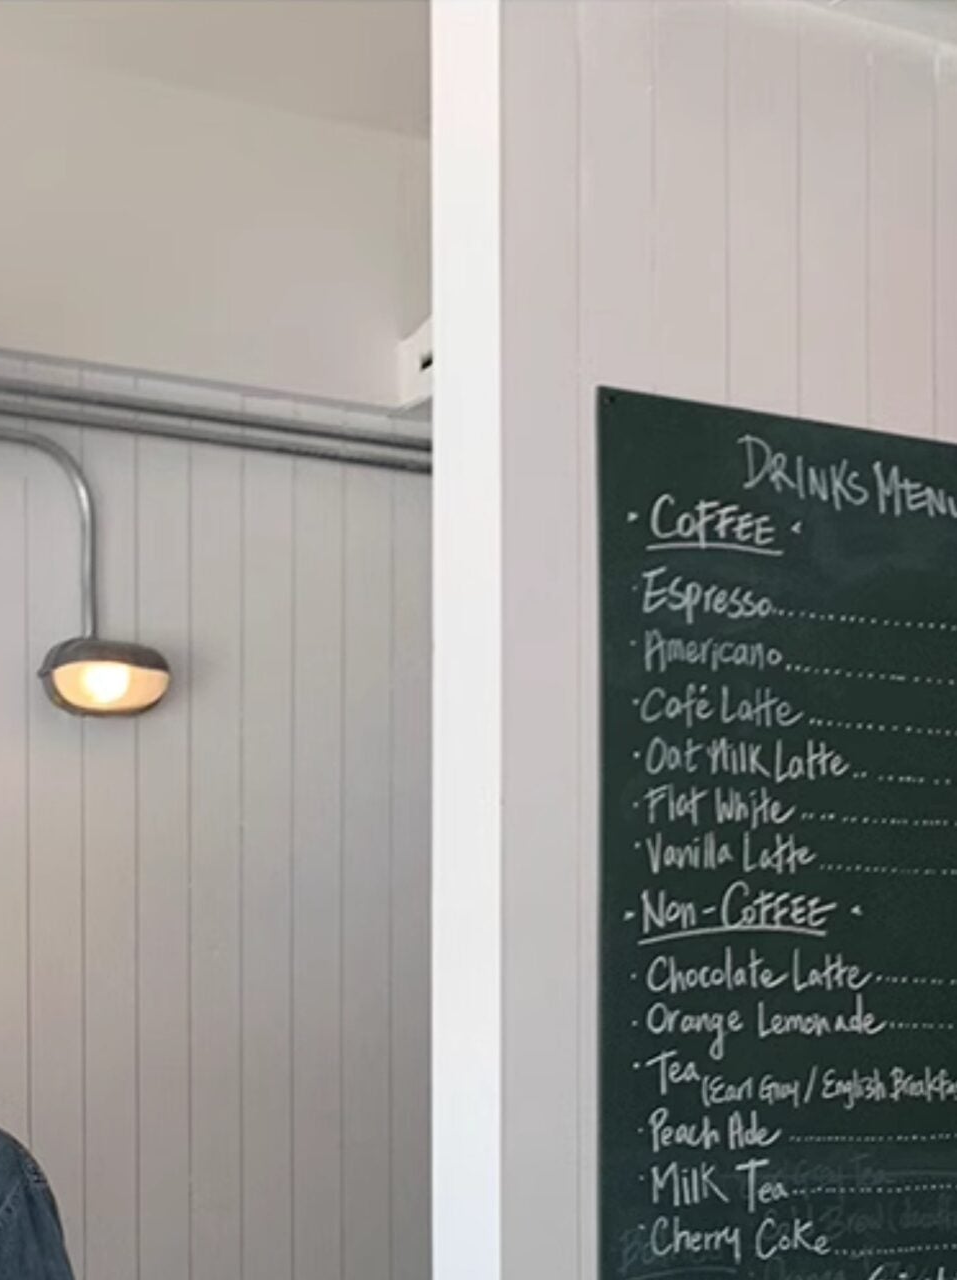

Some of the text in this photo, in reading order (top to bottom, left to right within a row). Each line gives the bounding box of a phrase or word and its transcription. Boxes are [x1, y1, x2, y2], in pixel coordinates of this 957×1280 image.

[738, 434, 870, 512] DRINKS
[642, 566, 774, 625] Espresso
[644, 629, 783, 673] Americano
[640, 683, 805, 729] Café Latte
[645, 736, 704, 776] Oat
[775, 739, 851, 783] Latte
[644, 783, 796, 829] Flat White
[645, 831, 818, 874] Vanilla Latte
[646, 946, 873, 994] Chocolate Latte
[646, 993, 888, 1061] Orange Lemonade
[645, 1050, 701, 1096] Tea
[648, 1107, 783, 1153] Peach Ade
[735, 1158, 789, 1214] Tea
[649, 1215, 742, 1264] Cherry
